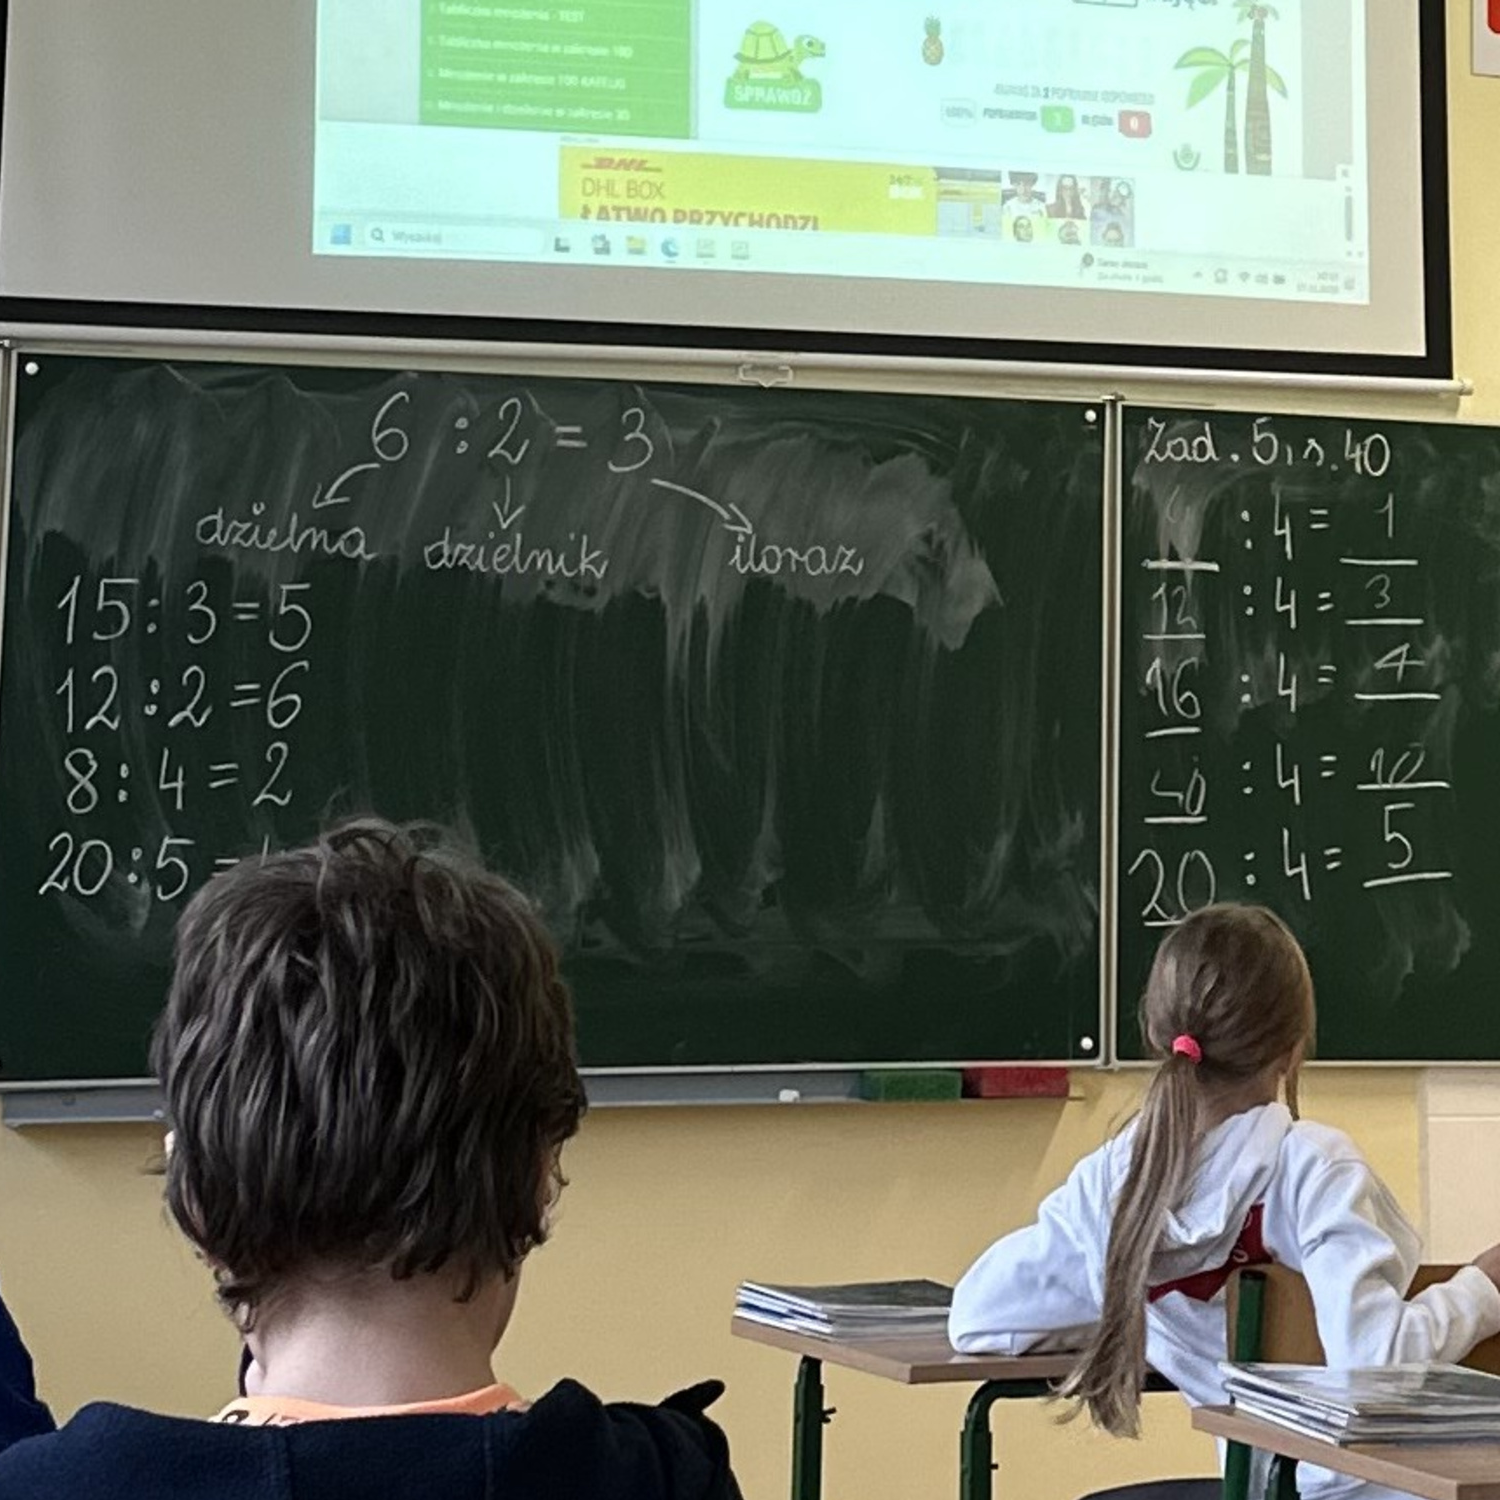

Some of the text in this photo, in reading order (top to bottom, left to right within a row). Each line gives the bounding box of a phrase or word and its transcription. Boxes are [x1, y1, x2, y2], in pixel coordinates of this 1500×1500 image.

[581, 177, 666, 201] DHL BOX
[371, 391, 410, 461] 6
[487, 396, 530, 466] 2
[607, 407, 654, 473] 3
[194, 501, 378, 561] dzielna
[422, 526, 610, 578] dzielnik
[726, 528, 866, 577] iloraz
[1151, 581, 1199, 635] 12
[1363, 573, 1393, 610] 3
[1144, 655, 1202, 720] 16
[1127, 848, 1218, 922] 20
[1383, 802, 1417, 870] 5
